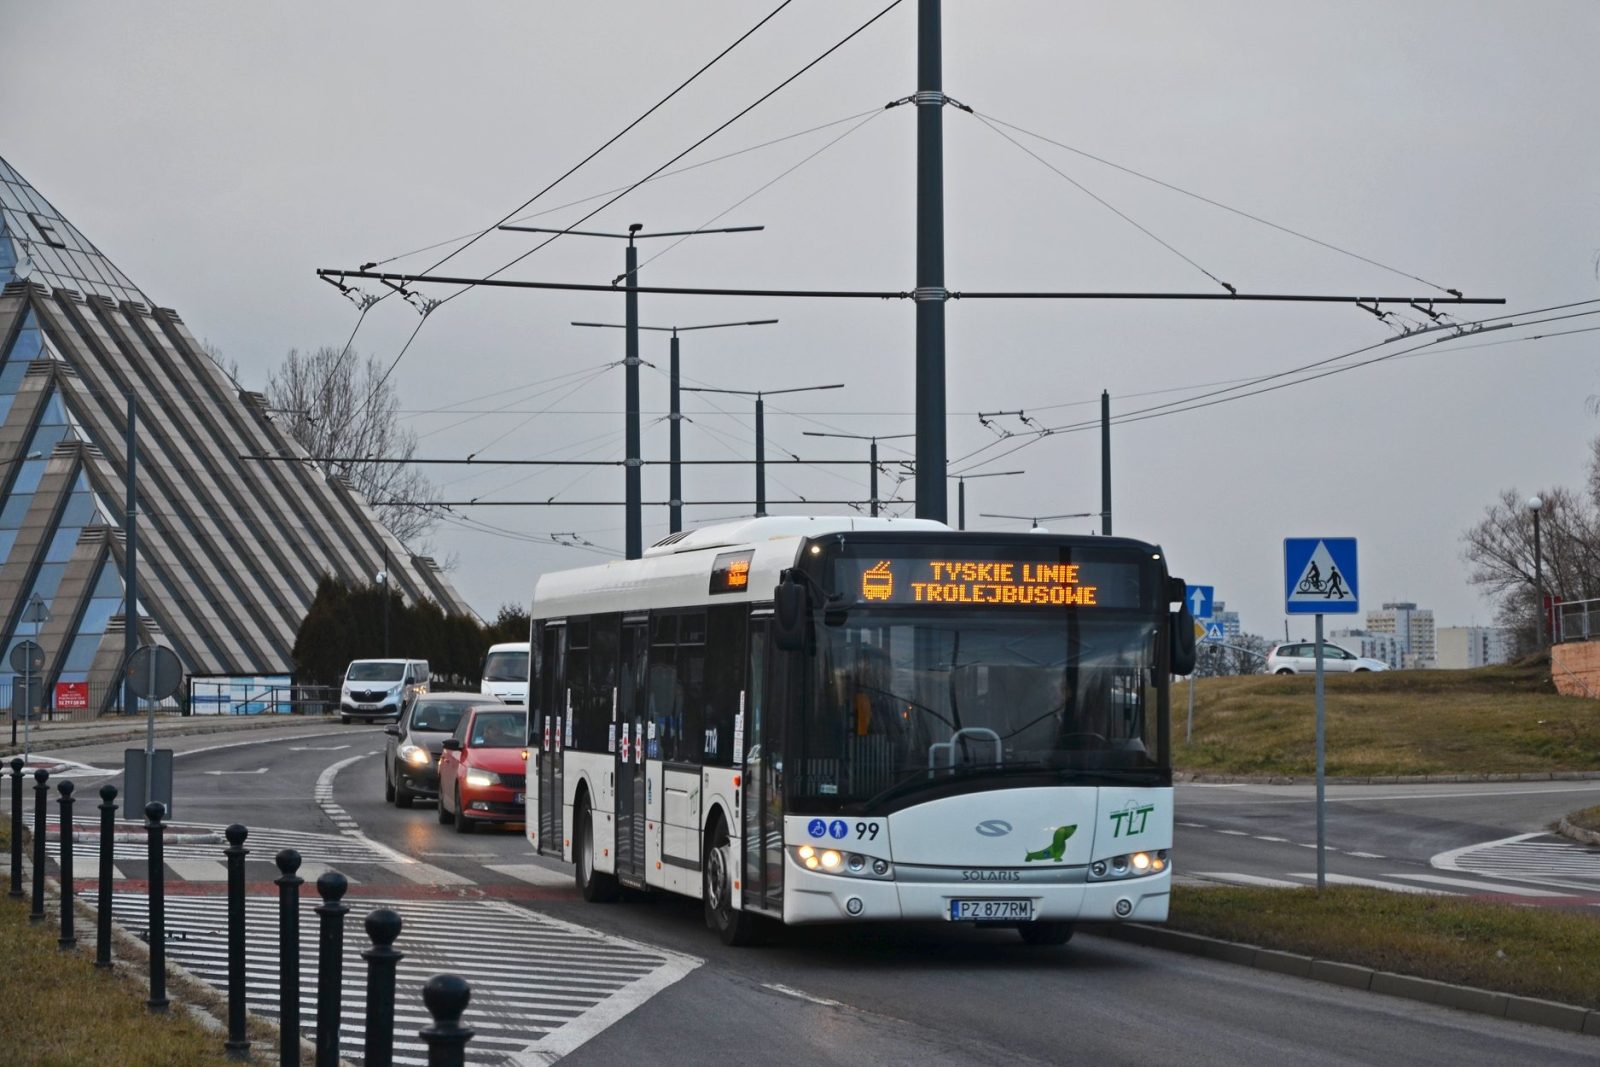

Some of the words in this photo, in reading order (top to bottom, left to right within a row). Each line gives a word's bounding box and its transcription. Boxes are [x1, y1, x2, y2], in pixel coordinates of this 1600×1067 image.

[930, 562, 1013, 582] TYSKIE
[1023, 564, 1079, 583] LINIE
[911, 583, 1096, 605] TROLEJBUSOWE
[856, 822, 879, 841] 99
[1110, 807, 1154, 838] TLT
[963, 871, 1020, 881] SOLARIS
[961, 902, 980, 917] PZ
[985, 902, 1028, 917] 877RM
